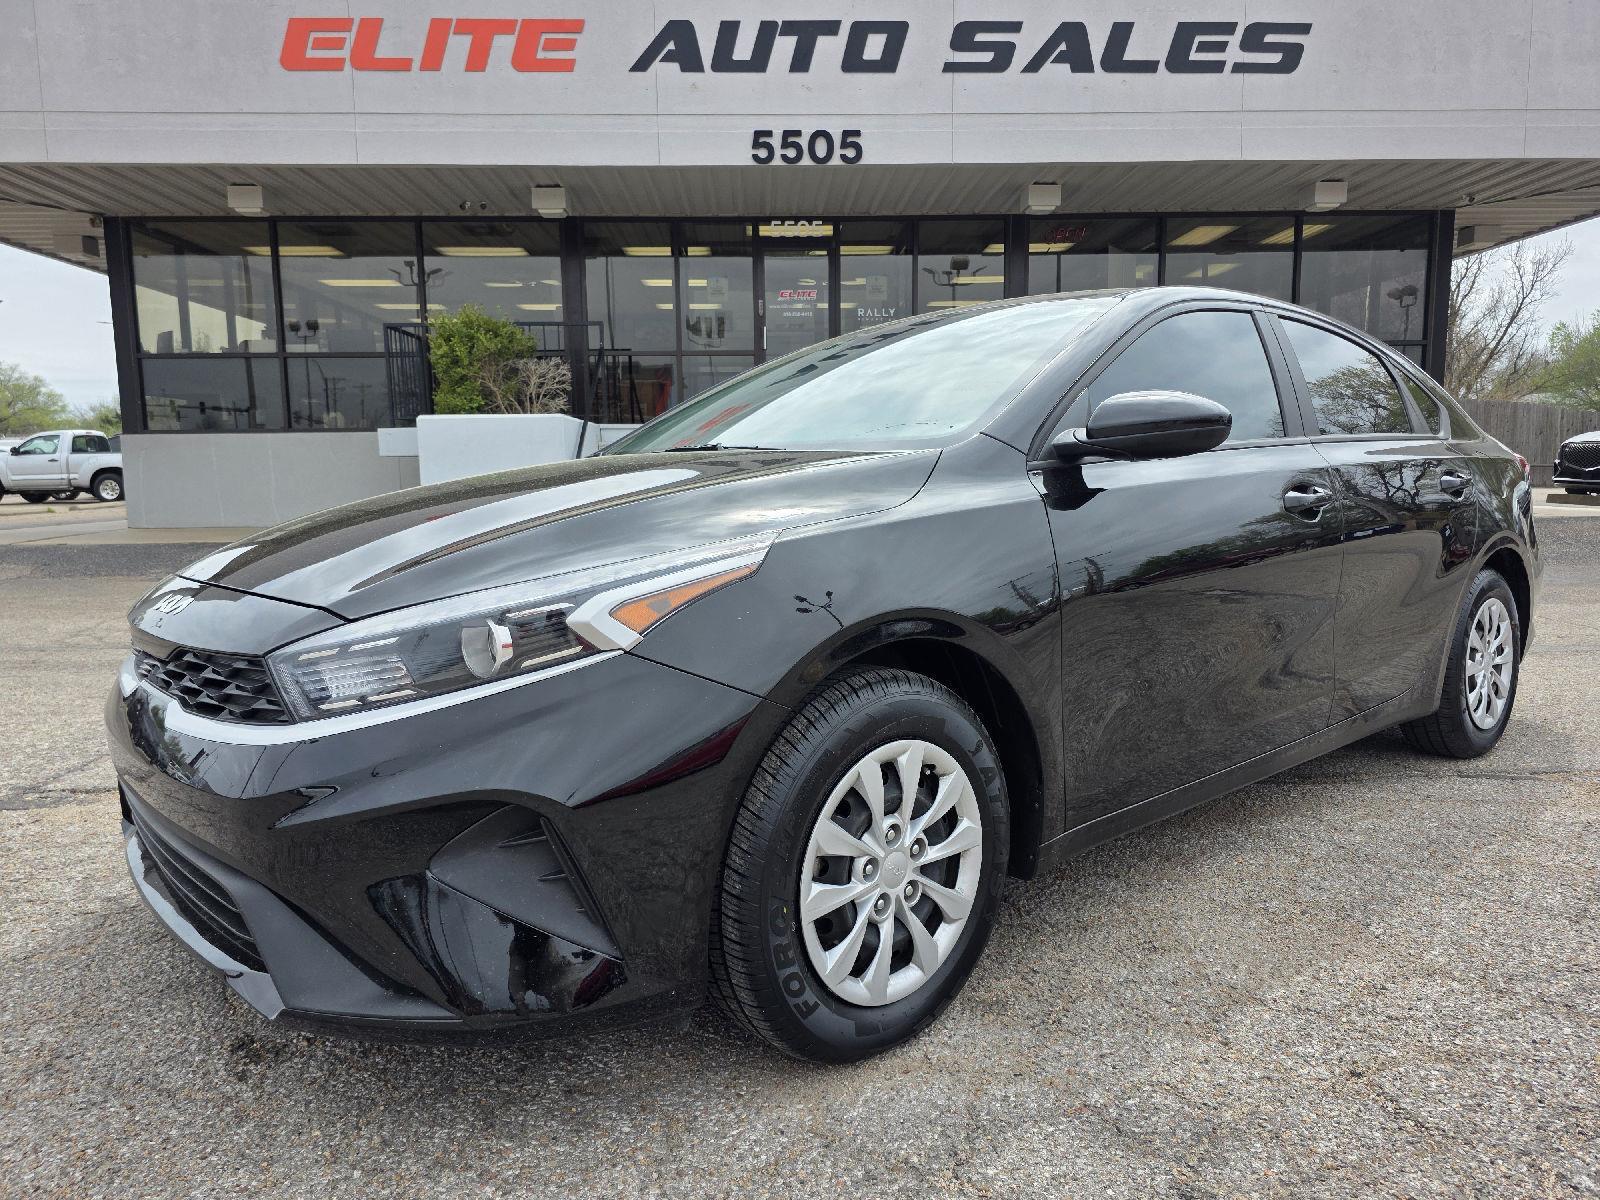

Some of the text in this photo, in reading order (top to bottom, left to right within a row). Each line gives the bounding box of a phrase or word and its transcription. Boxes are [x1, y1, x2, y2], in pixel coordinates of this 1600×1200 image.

[279, 17, 1313, 75] ELITE AUTO SALES
[752, 129, 863, 165] 5505
[770, 220, 823, 237] 5505
[780, 290, 817, 298] ELITE
[857, 308, 896, 317] RALLY
